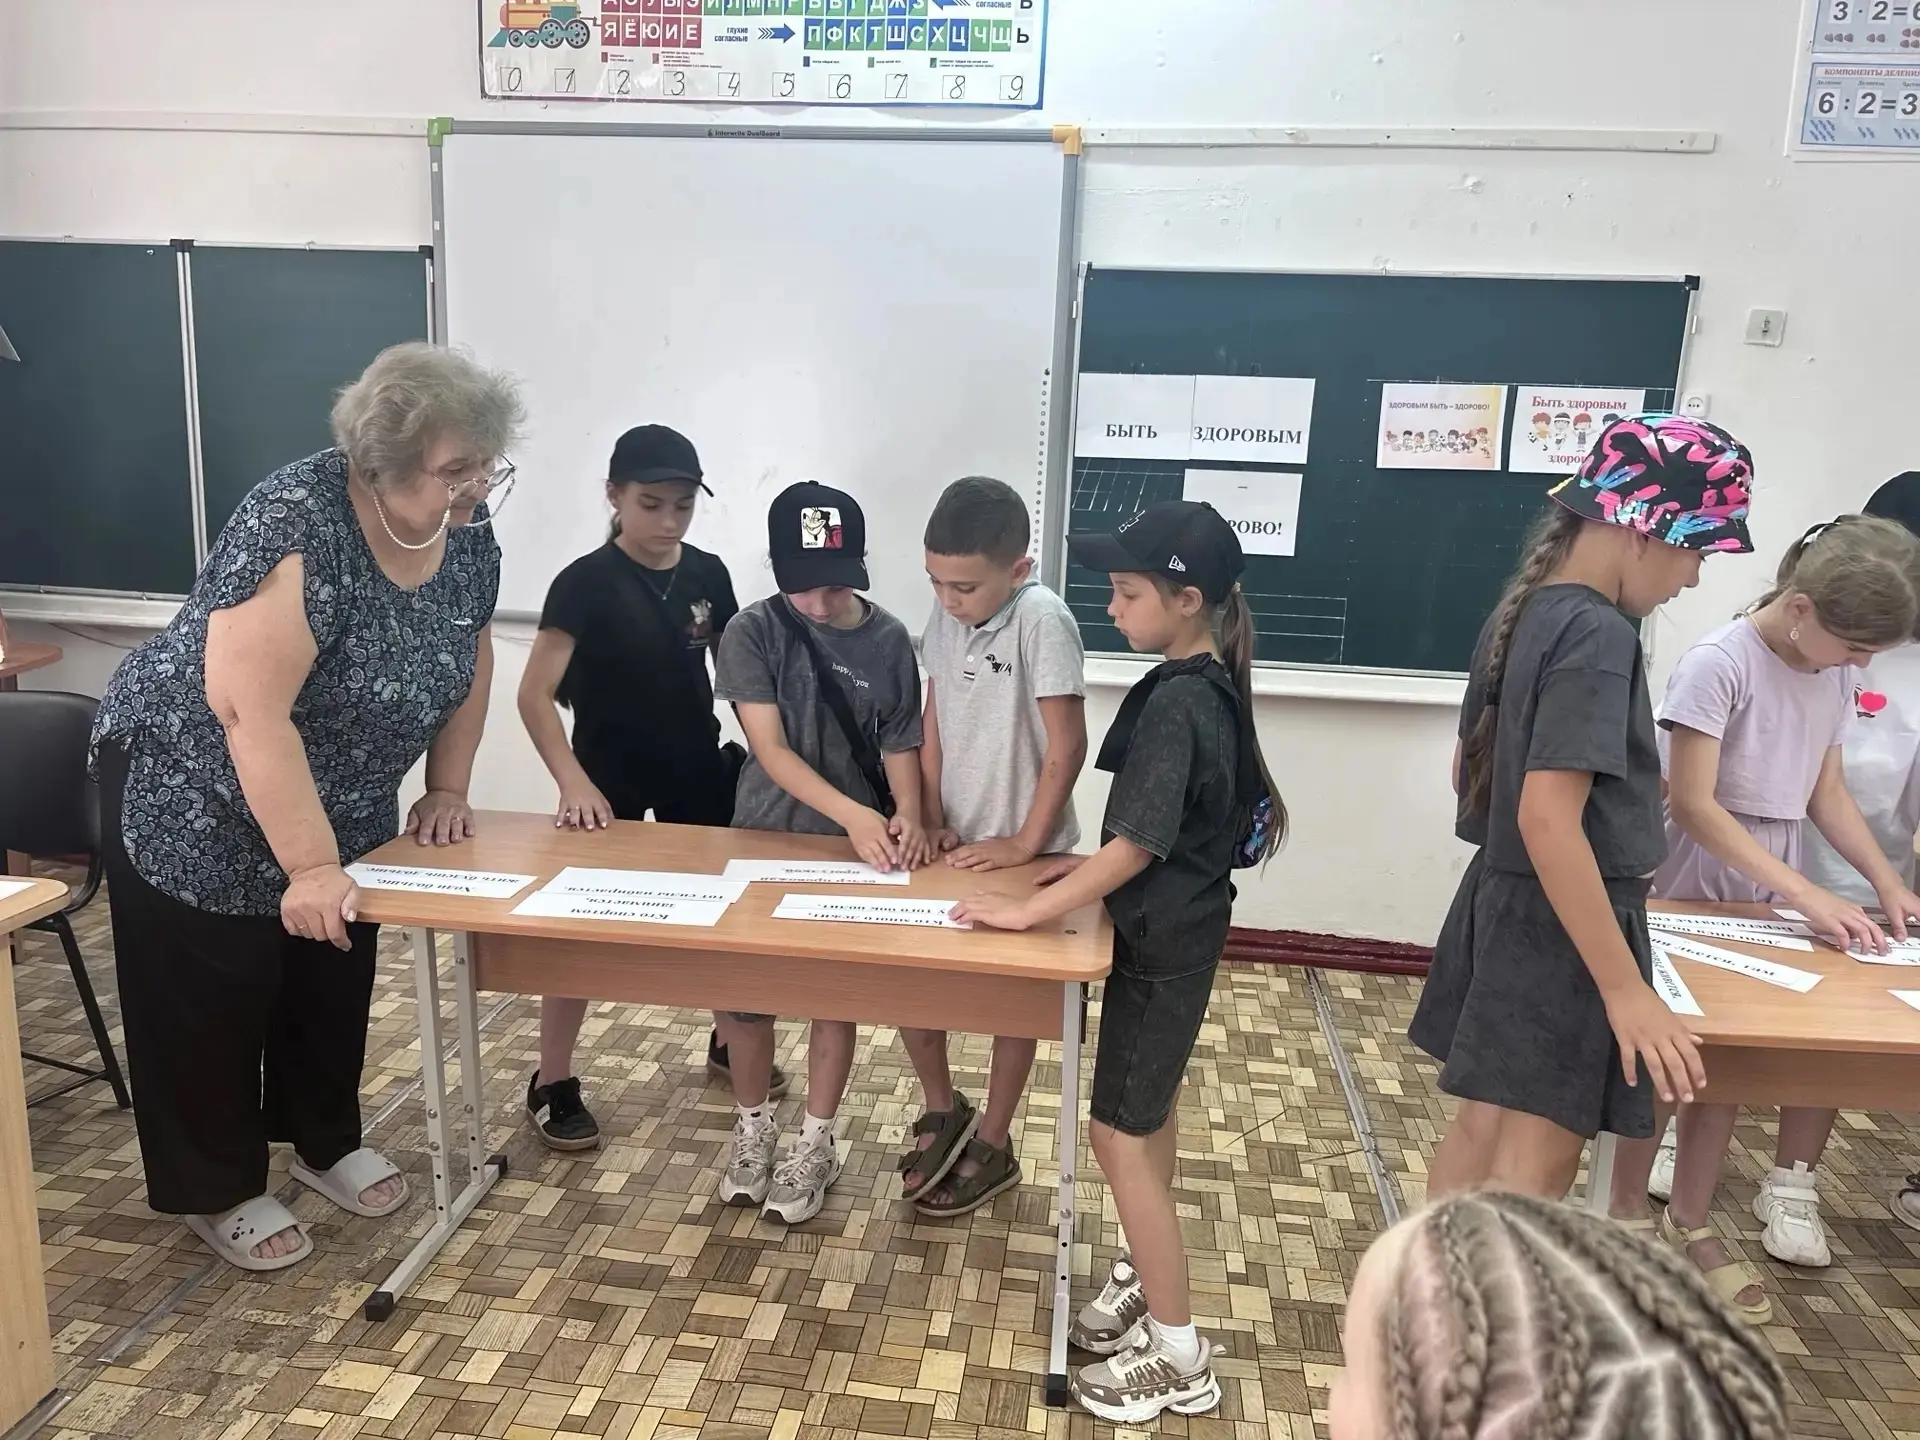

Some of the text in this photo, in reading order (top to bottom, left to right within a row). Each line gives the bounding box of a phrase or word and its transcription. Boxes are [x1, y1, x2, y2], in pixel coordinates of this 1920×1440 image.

[508, 67, 1024, 100] 0 1 2 3 4 5 6 7 8 9
[1454, 403, 1490, 411] ЗДОРОВО!
[1532, 396, 1627, 411] Быть здоровым
[1105, 424, 1158, 439] БЫТЬ
[1193, 426, 1302, 445] ЗДОРОВЫМ
[570, 908, 669, 920] Кто спортом
